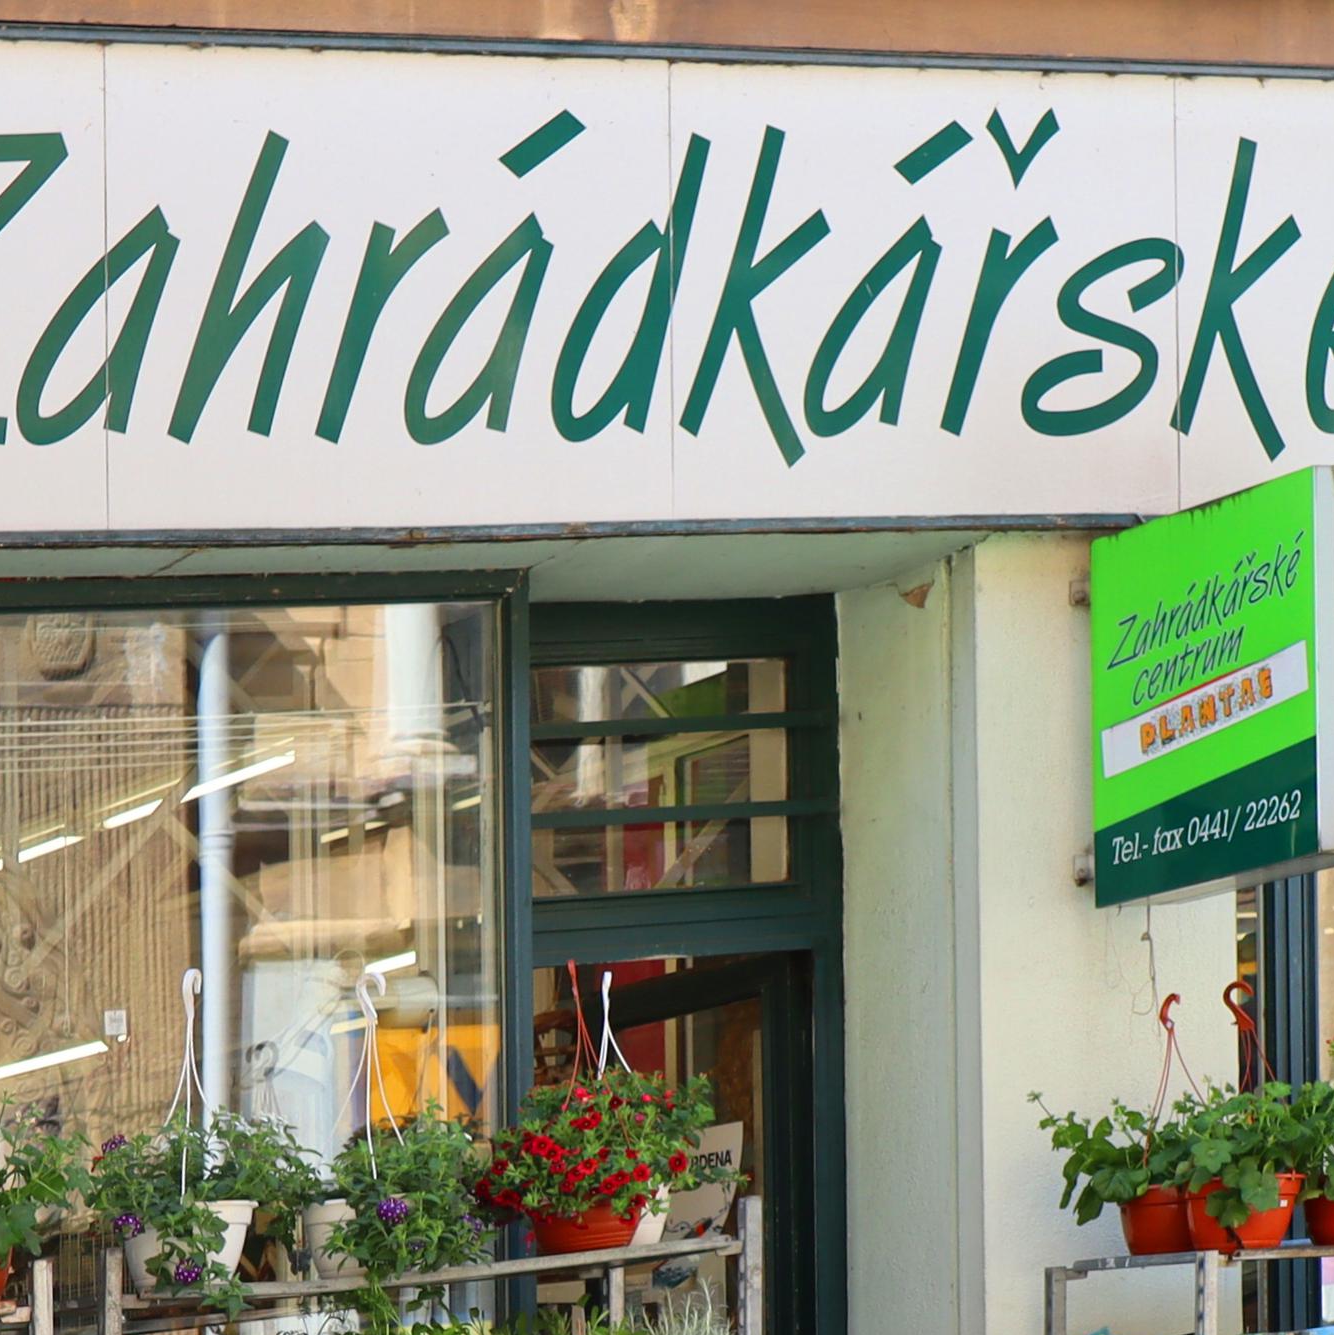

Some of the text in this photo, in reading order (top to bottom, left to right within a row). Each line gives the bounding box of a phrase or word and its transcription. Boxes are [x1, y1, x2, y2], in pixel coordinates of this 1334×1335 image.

[1107, 529, 1307, 671] Zahrádkářské
[1132, 625, 1246, 707] centrum
[1138, 667, 1274, 755] PLANTAE
[1152, 824, 1184, 857] fax
[1244, 789, 1303, 833] 22262
[690, 1149, 734, 1171] RDENA
